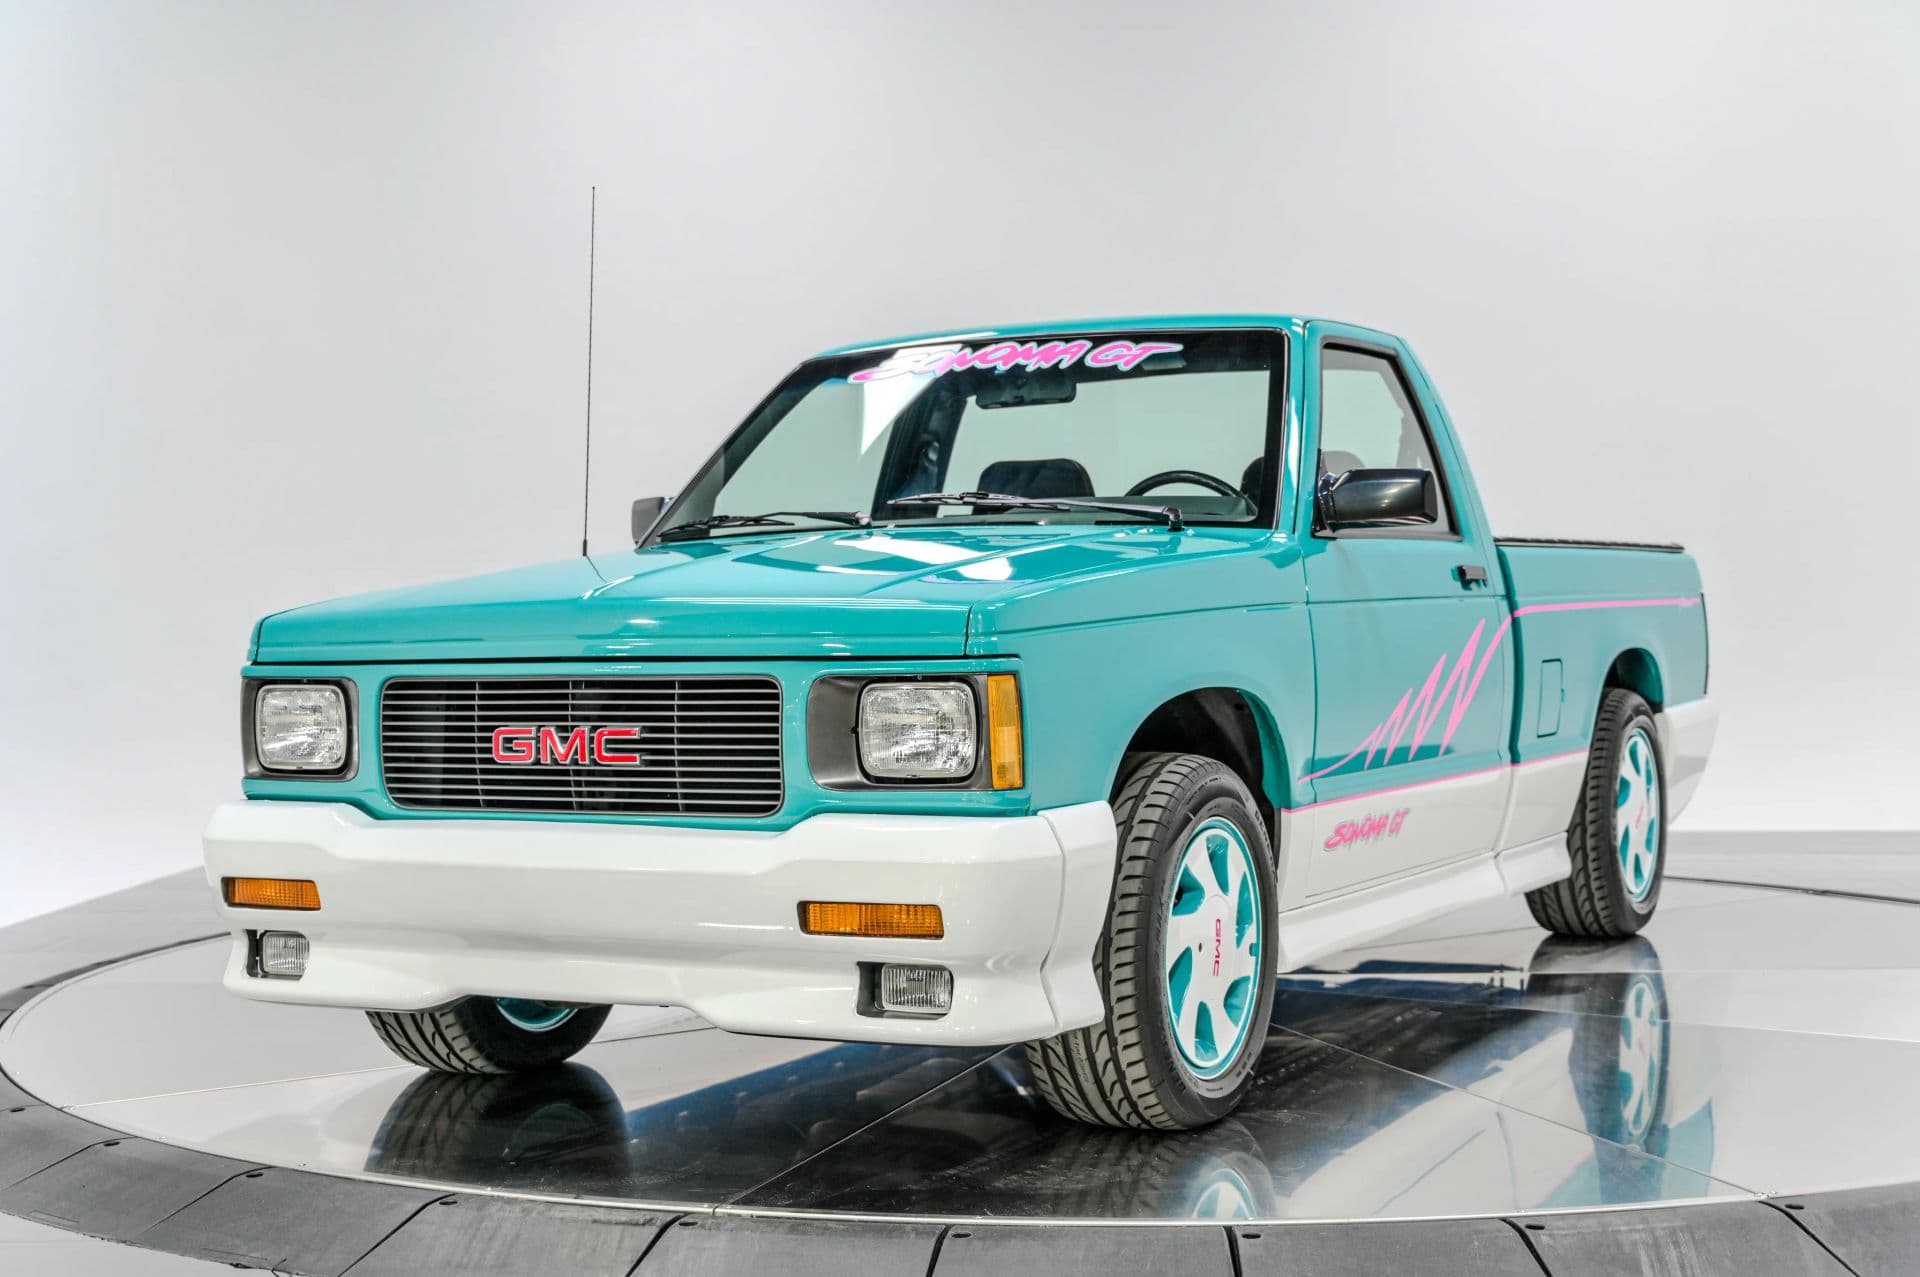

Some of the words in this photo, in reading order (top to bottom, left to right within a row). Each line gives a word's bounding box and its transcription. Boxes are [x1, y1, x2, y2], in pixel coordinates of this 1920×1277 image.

[847, 341, 1092, 384] SONOMA
[1085, 342, 1184, 371] GT
[492, 727, 641, 765] GMC
[1213, 918, 1221, 977] GMC
